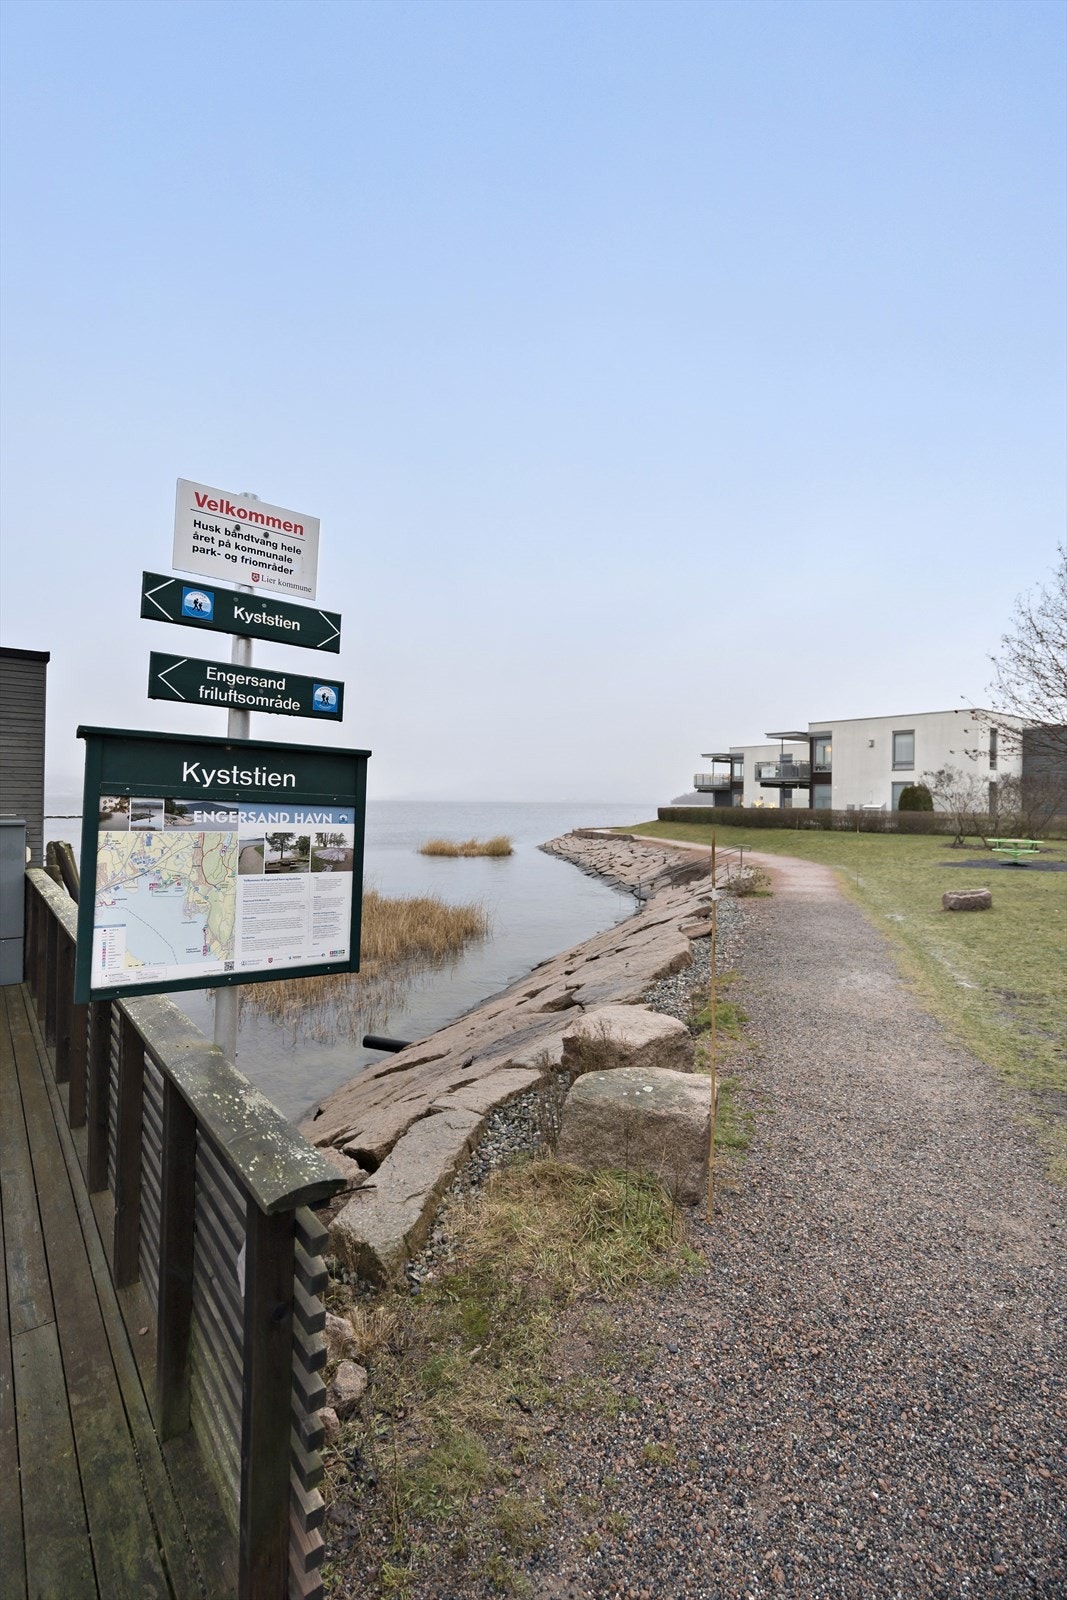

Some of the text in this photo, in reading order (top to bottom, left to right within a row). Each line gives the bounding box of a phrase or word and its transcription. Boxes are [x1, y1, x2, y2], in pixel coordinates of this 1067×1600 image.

[194, 492, 304, 536] Velkommen
[192, 532, 293, 564] året på kommunale
[194, 520, 302, 555] Husk båndtvang hele
[192, 544, 294, 575] park- og friområder
[261, 575, 312, 593] Lier kommune
[234, 606, 300, 632] Kyststien
[206, 666, 286, 691] Engersand
[198, 686, 300, 711] friluftsområde
[182, 762, 296, 788] Kyststien
[194, 810, 332, 824] ENGERSAND HAVN
